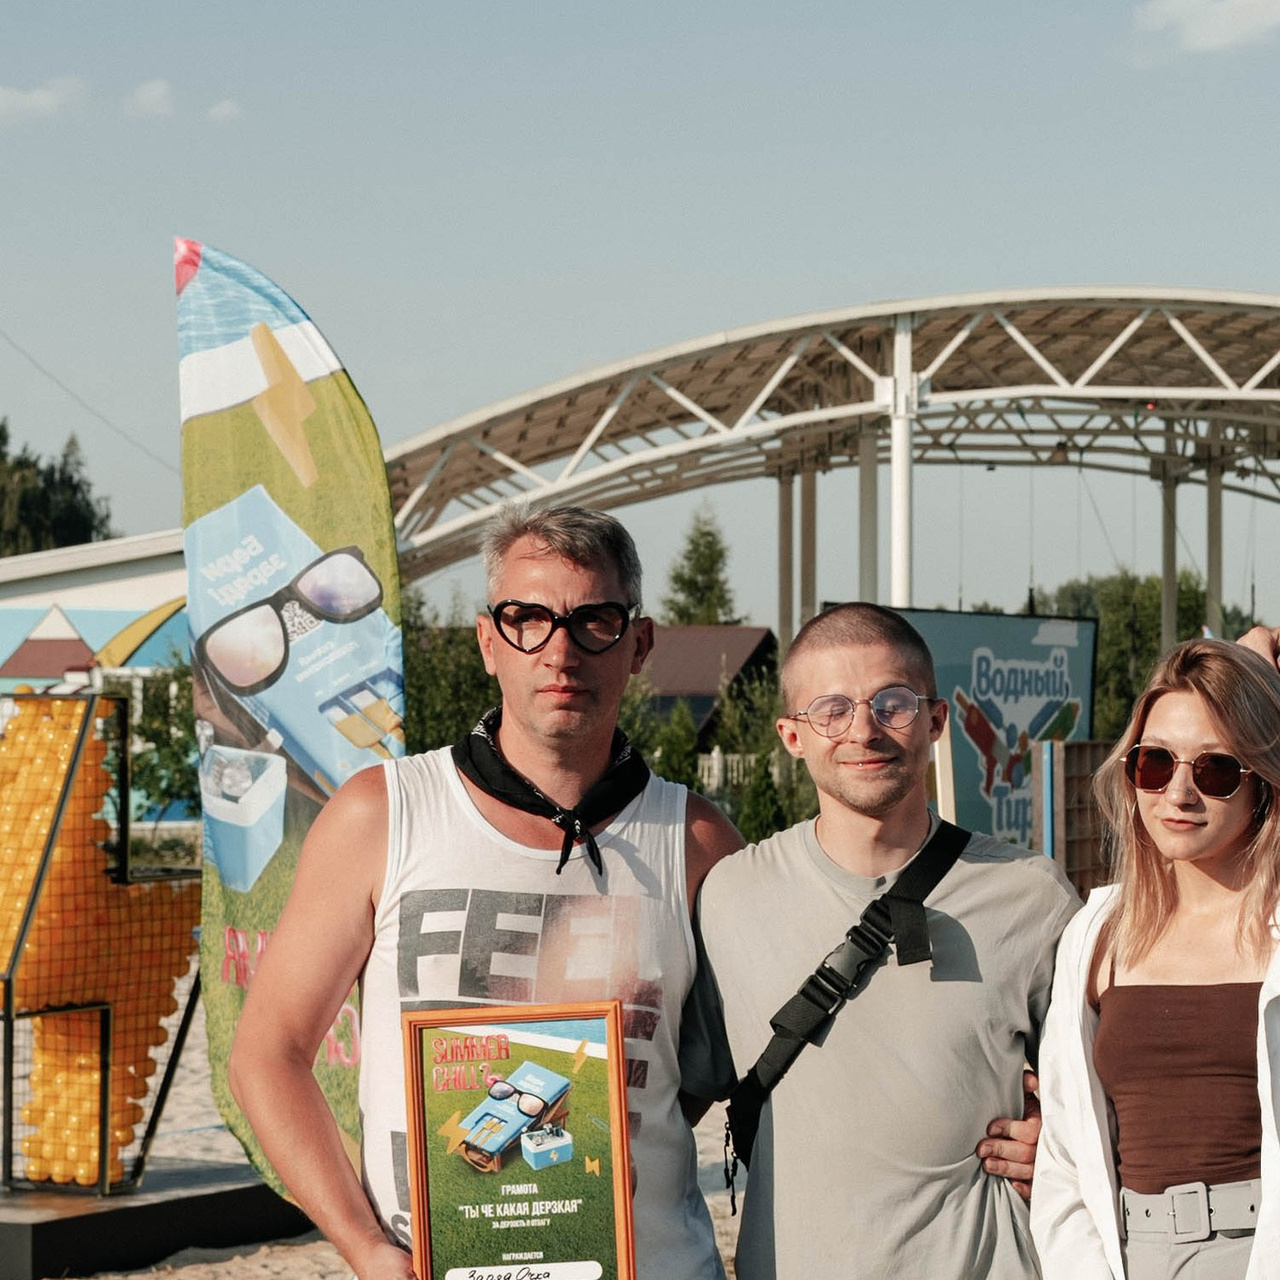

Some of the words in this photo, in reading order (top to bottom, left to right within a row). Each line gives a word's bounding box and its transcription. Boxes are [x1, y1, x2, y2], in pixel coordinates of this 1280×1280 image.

[975, 655, 1066, 704] Водный
[397, 888, 663, 1004] FEEL
[432, 1033, 511, 1064] SUMMER
[432, 1064, 482, 1093] CHILL
[501, 1183, 539, 1196] ГРАМОТА
[481, 1203, 493, 1218] ЧЕ
[496, 1202, 530, 1218] КАКАЯ
[531, 1198, 583, 1217] ДЕРЗКАЯ"
